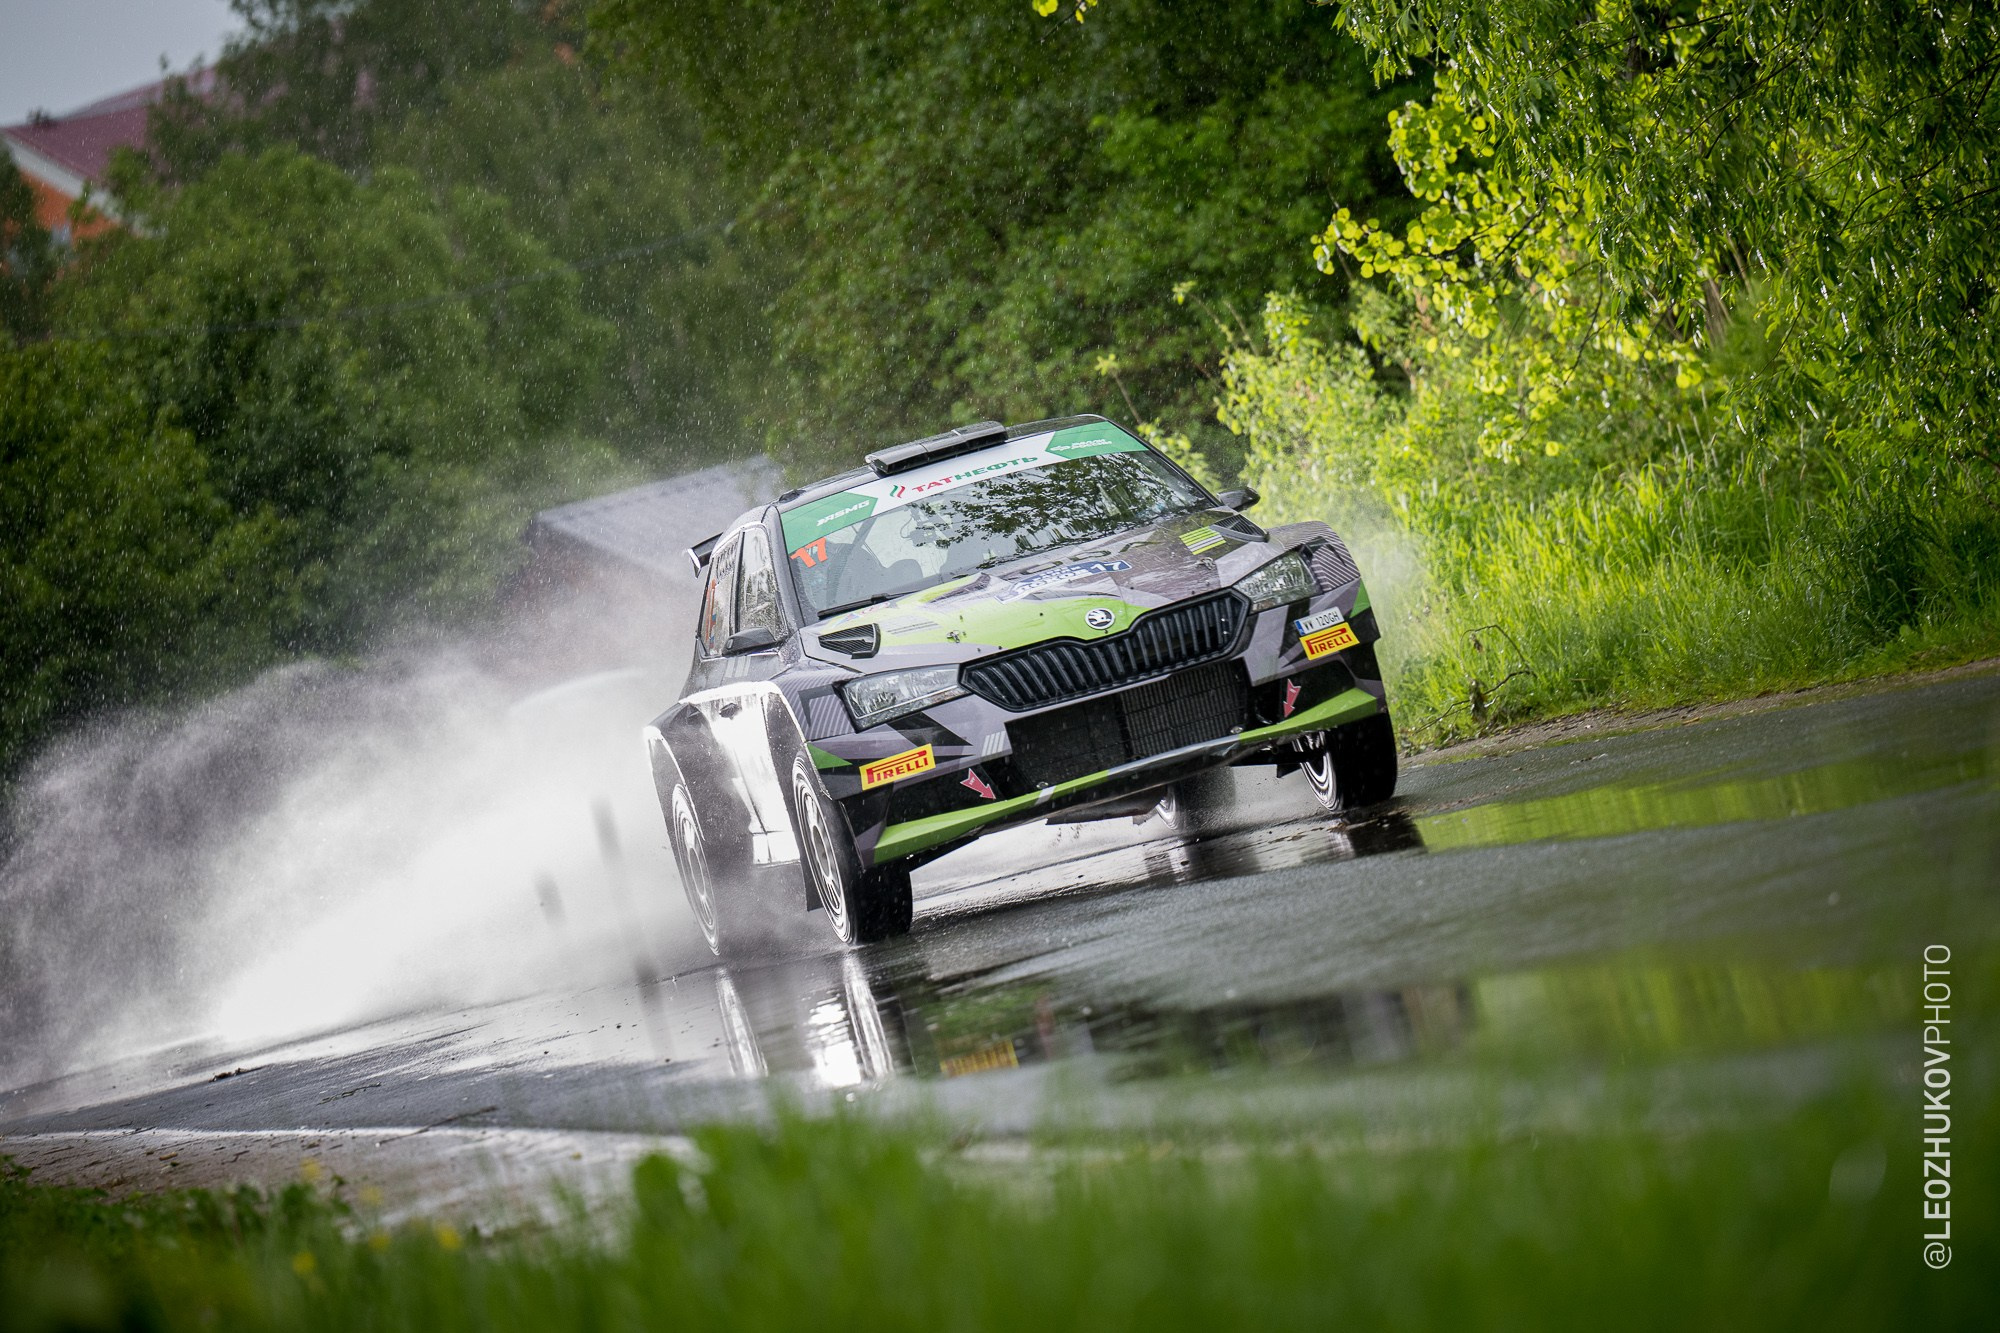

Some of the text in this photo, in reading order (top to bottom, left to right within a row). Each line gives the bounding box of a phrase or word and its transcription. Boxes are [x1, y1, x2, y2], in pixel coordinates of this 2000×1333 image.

[912, 456, 1039, 493] ТАТНЕФТЬ
[789, 536, 829, 569] 17
[1091, 561, 1122, 573] 17
[1305, 627, 1353, 655] PIRELLI
[866, 749, 929, 785] PIRELLI
